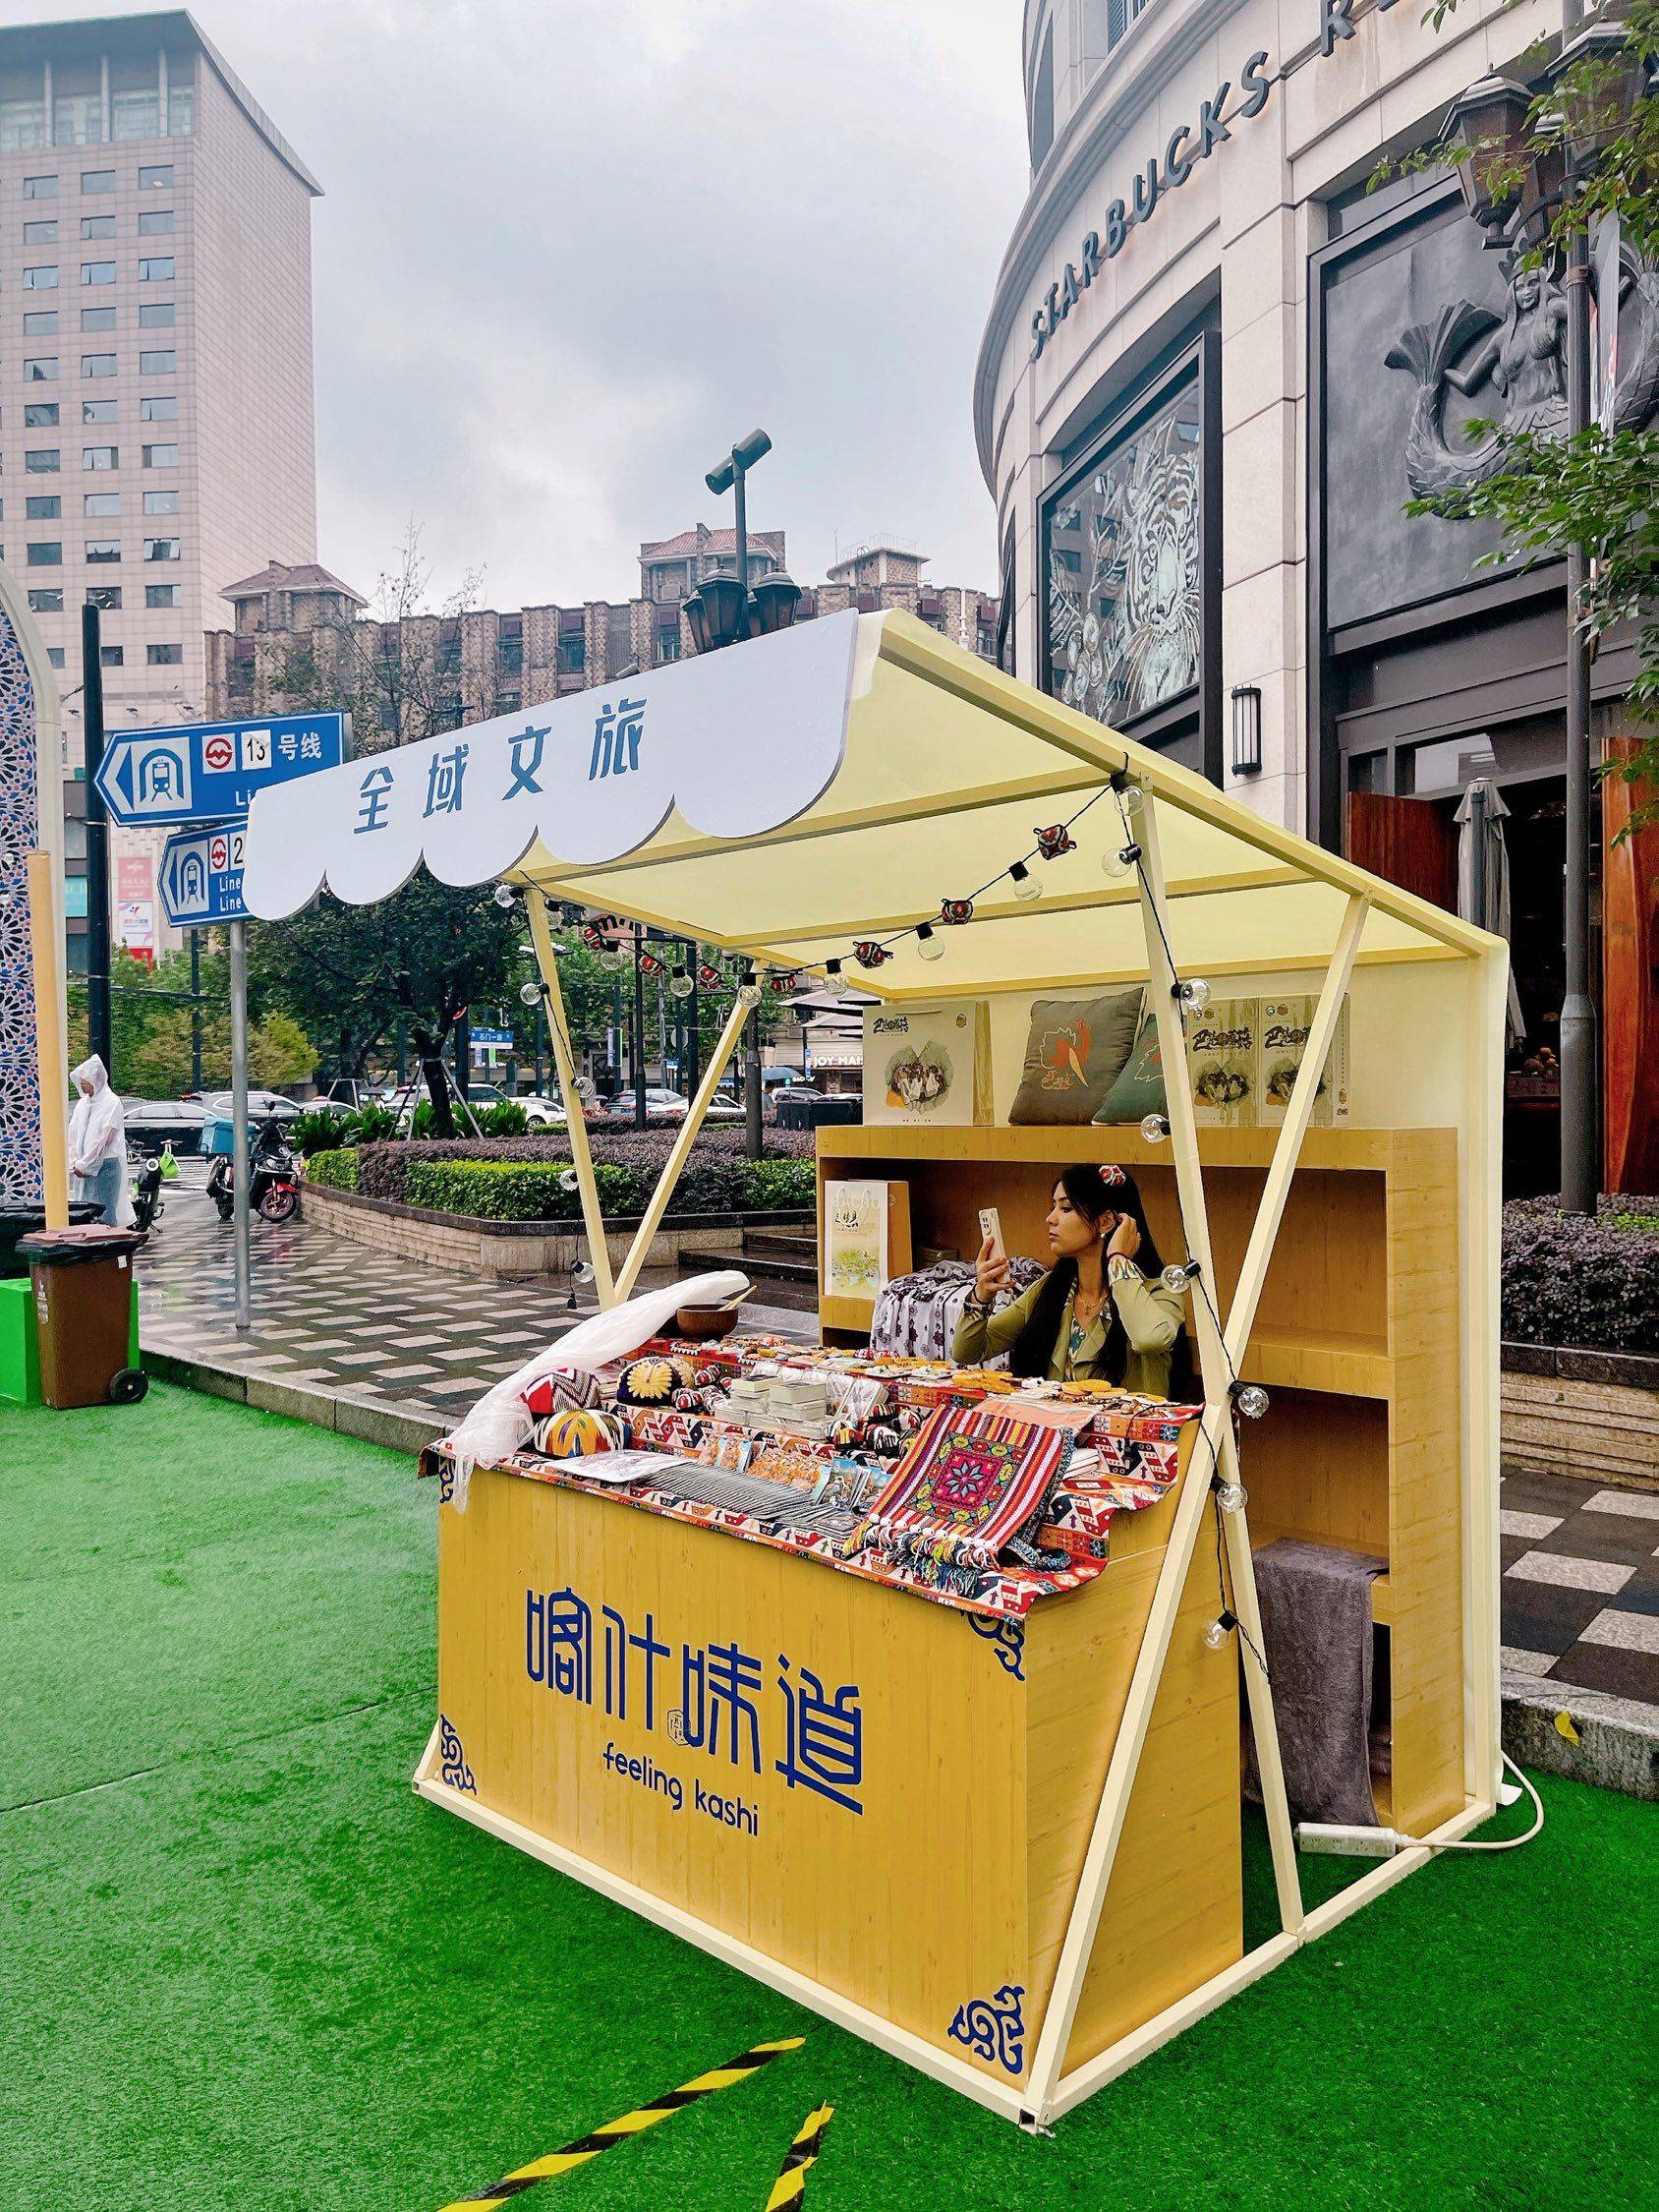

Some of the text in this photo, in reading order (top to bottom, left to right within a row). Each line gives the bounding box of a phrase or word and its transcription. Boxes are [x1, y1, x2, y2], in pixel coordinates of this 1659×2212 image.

[1030, 0, 1401, 361] STARBUCKS R
[277, 731, 322, 761] 号线
[353, 698, 648, 835] 全域文旅
[236, 789, 253, 806] Li
[233, 837, 244, 864] 2
[219, 876, 242, 893] Line
[219, 896, 242, 912] Line
[814, 1056, 834, 1068] JOY
[525, 1586, 864, 1816] 喀什味道
[602, 1742, 759, 1837] feeling kashi
